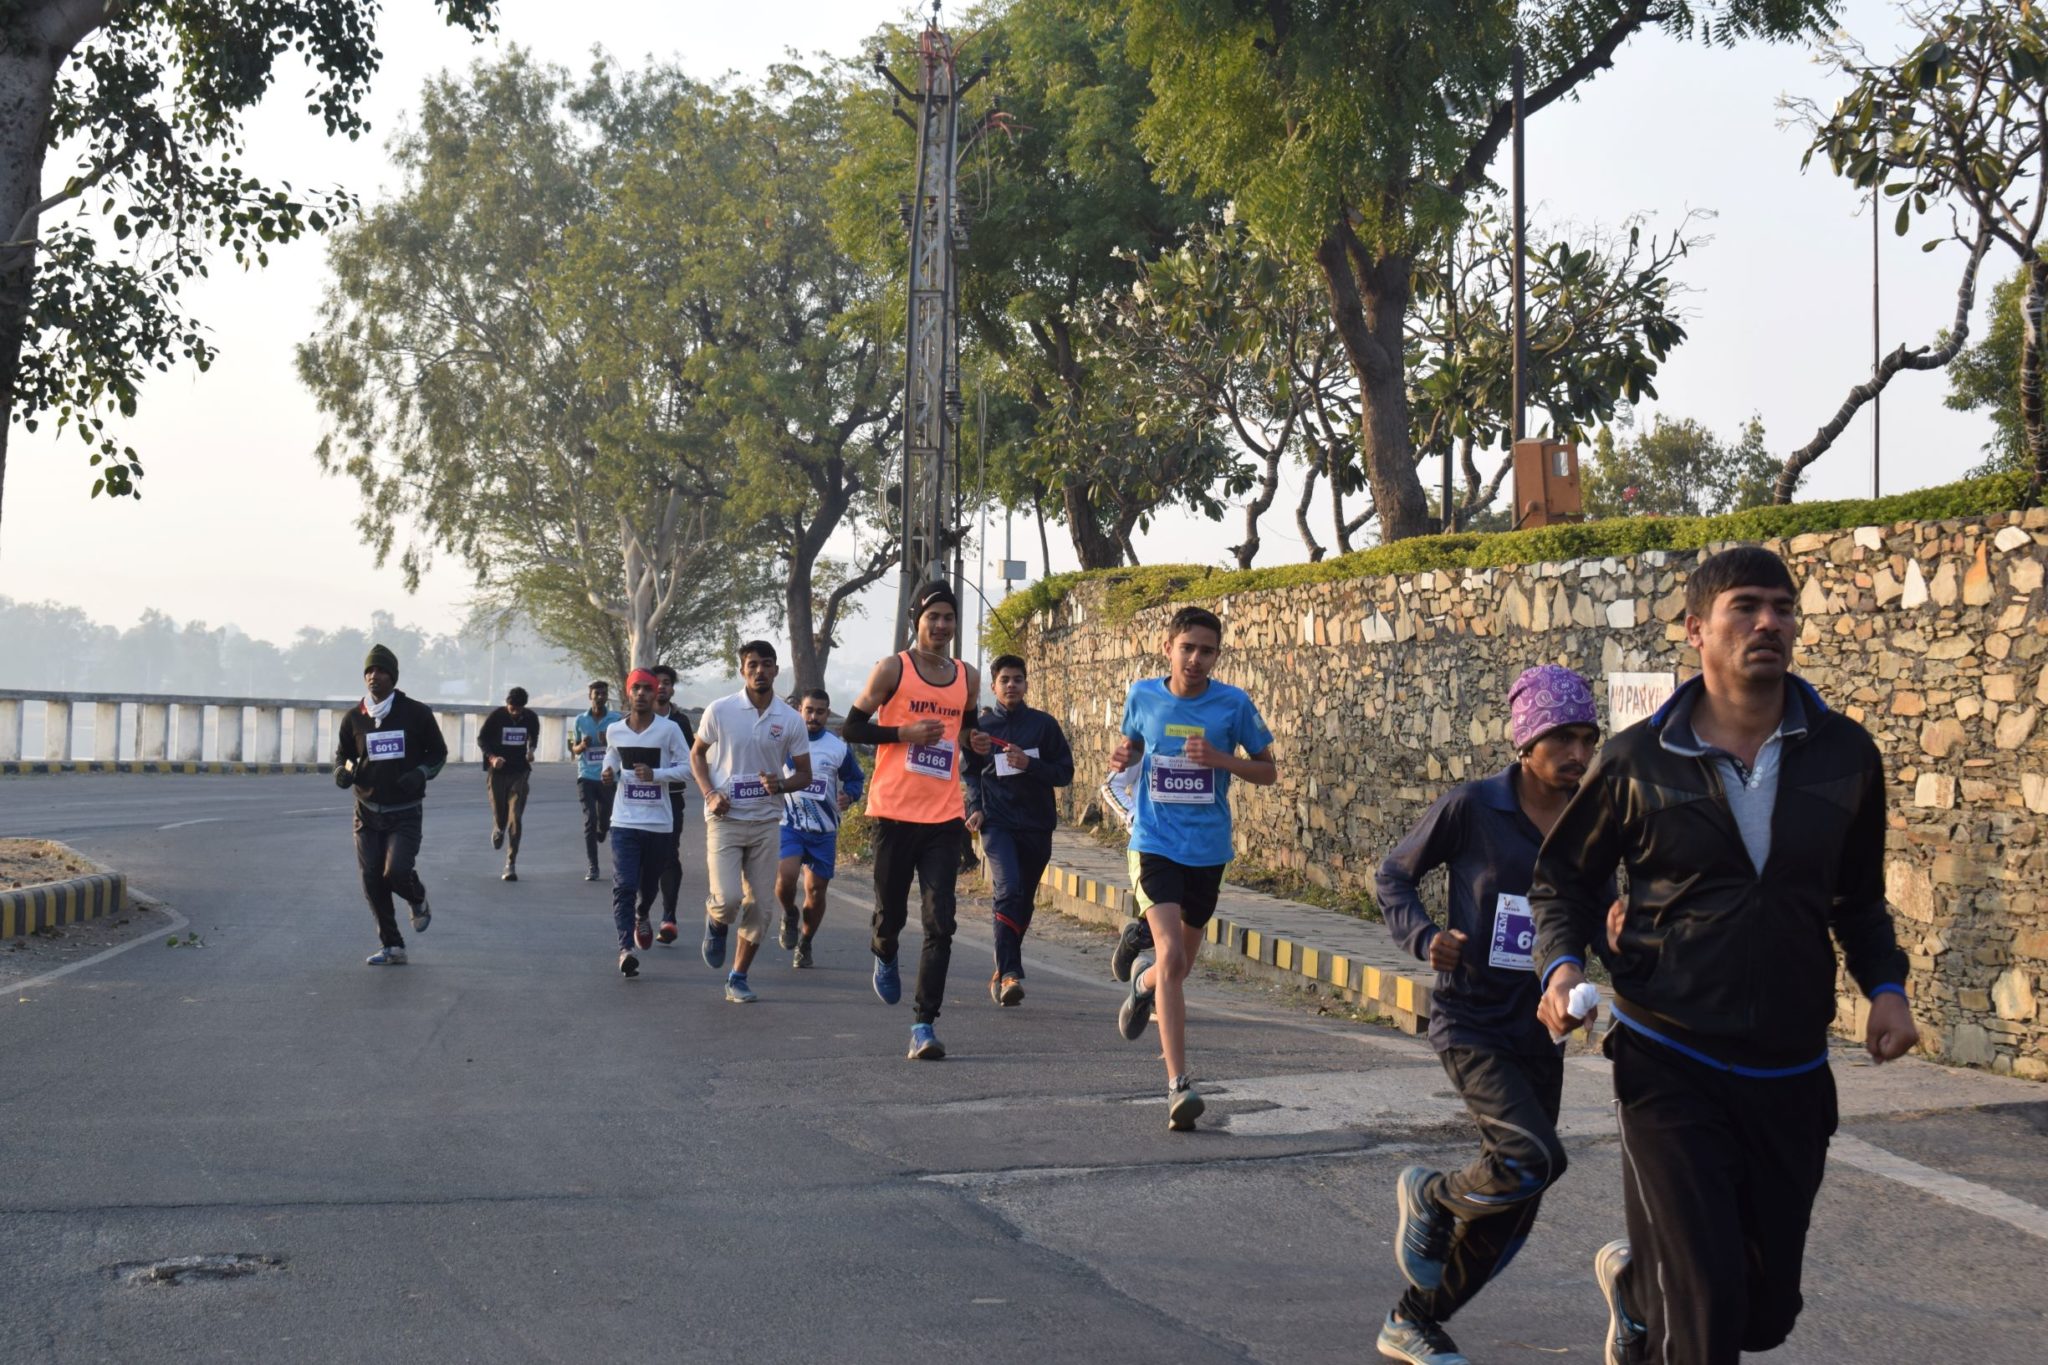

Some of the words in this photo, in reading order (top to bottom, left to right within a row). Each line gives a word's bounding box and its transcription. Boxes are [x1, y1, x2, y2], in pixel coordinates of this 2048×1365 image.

[375, 743, 399, 752] 6013
[917, 752, 946, 767] 6166
[1164, 777, 1204, 790] 6096
[632, 790, 656, 798] 6045
[739, 786, 766, 797] 6085
[1497, 912, 1509, 934] KM
